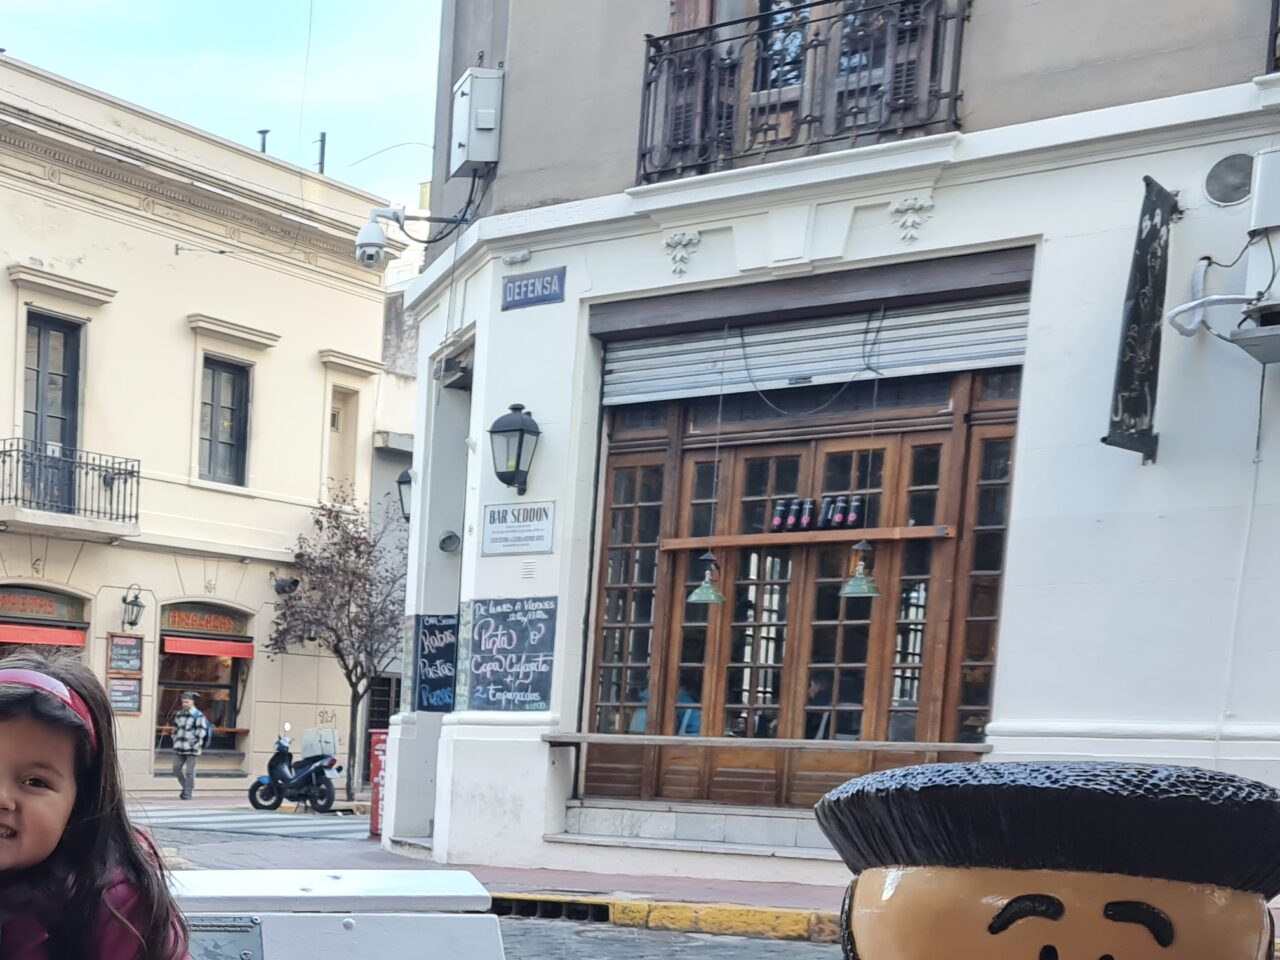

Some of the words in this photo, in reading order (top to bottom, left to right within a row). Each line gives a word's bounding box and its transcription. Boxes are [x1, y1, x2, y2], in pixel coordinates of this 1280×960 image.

[506, 275, 560, 301] DEFENSA
[489, 509, 508, 524] BAR
[511, 506, 549, 523] SEDDON
[0, 593, 56, 615] PASTAS
[421, 629, 455, 654] Rabas
[474, 617, 517, 655] Pinta
[420, 659, 454, 680] Pastas
[471, 655, 505, 679] Copa
[474, 686, 486, 698] 2
[487, 683, 541, 709] Empanadas
